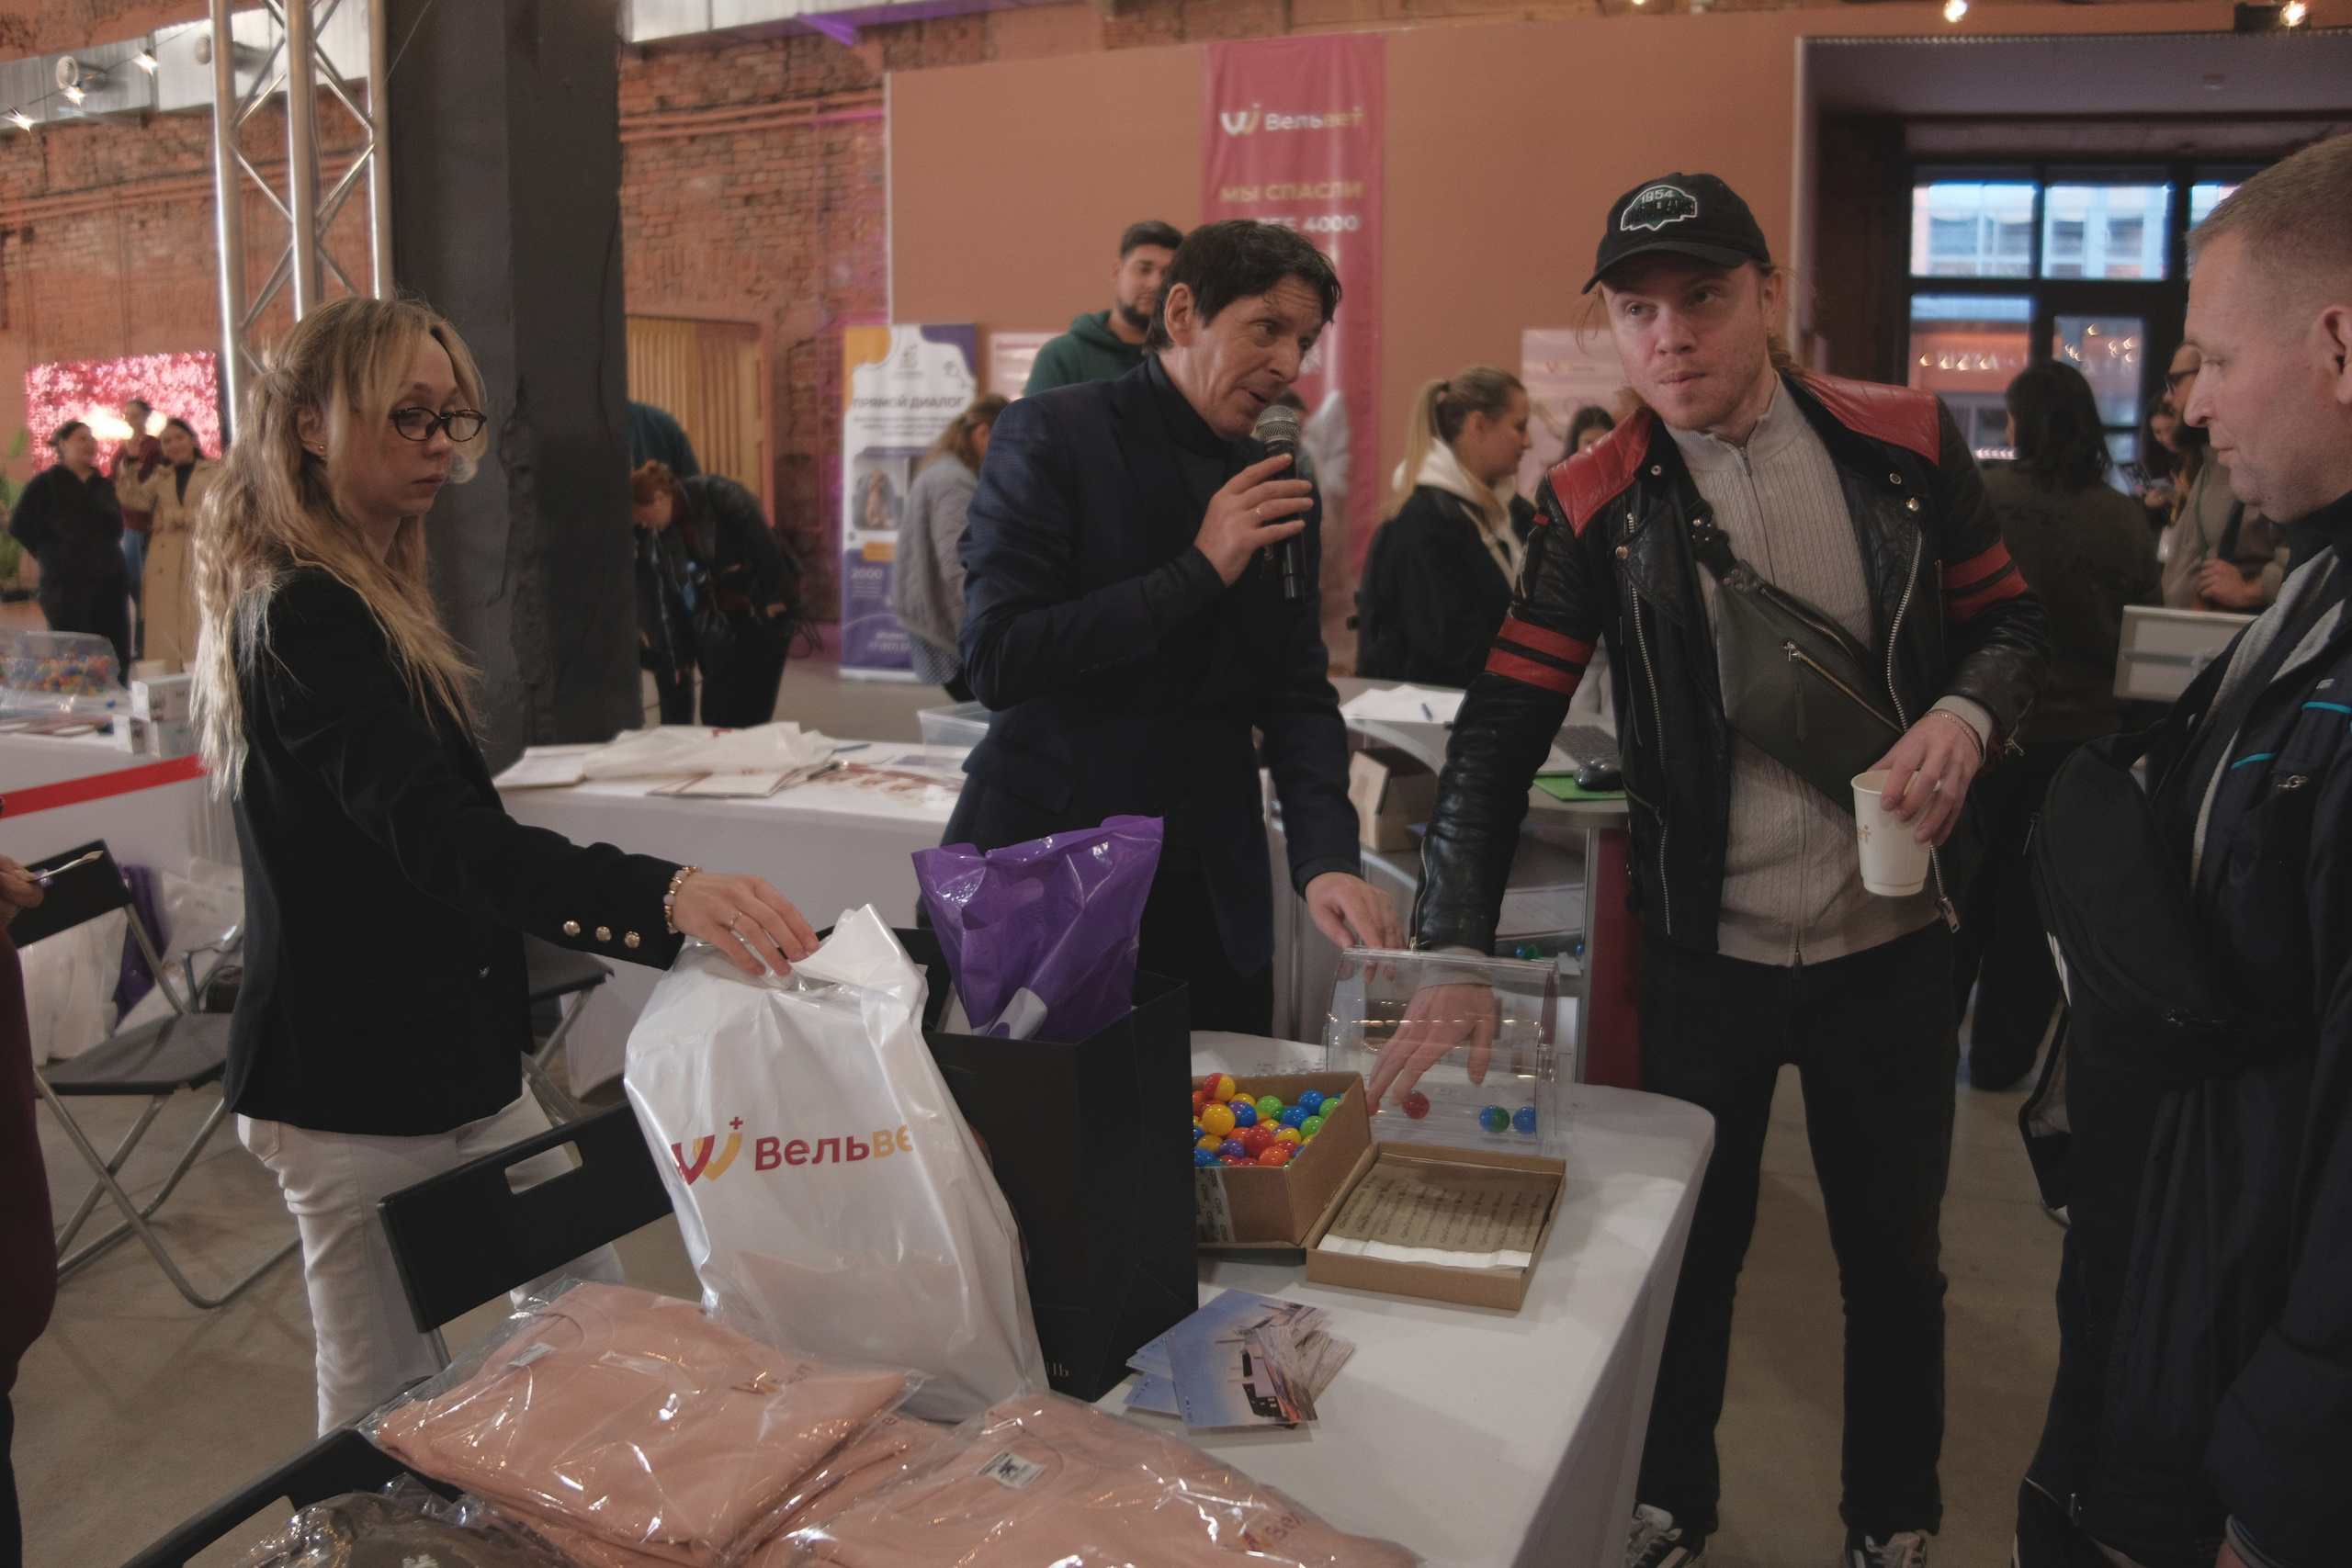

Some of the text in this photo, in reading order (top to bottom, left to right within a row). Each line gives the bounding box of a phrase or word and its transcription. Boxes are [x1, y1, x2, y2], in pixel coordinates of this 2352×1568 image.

[1220, 186, 1261, 203] МЫ
[1303, 214, 1359, 232] 4000
[853, 395, 965, 409] ПРЯМОЙ ДИАЛОГ
